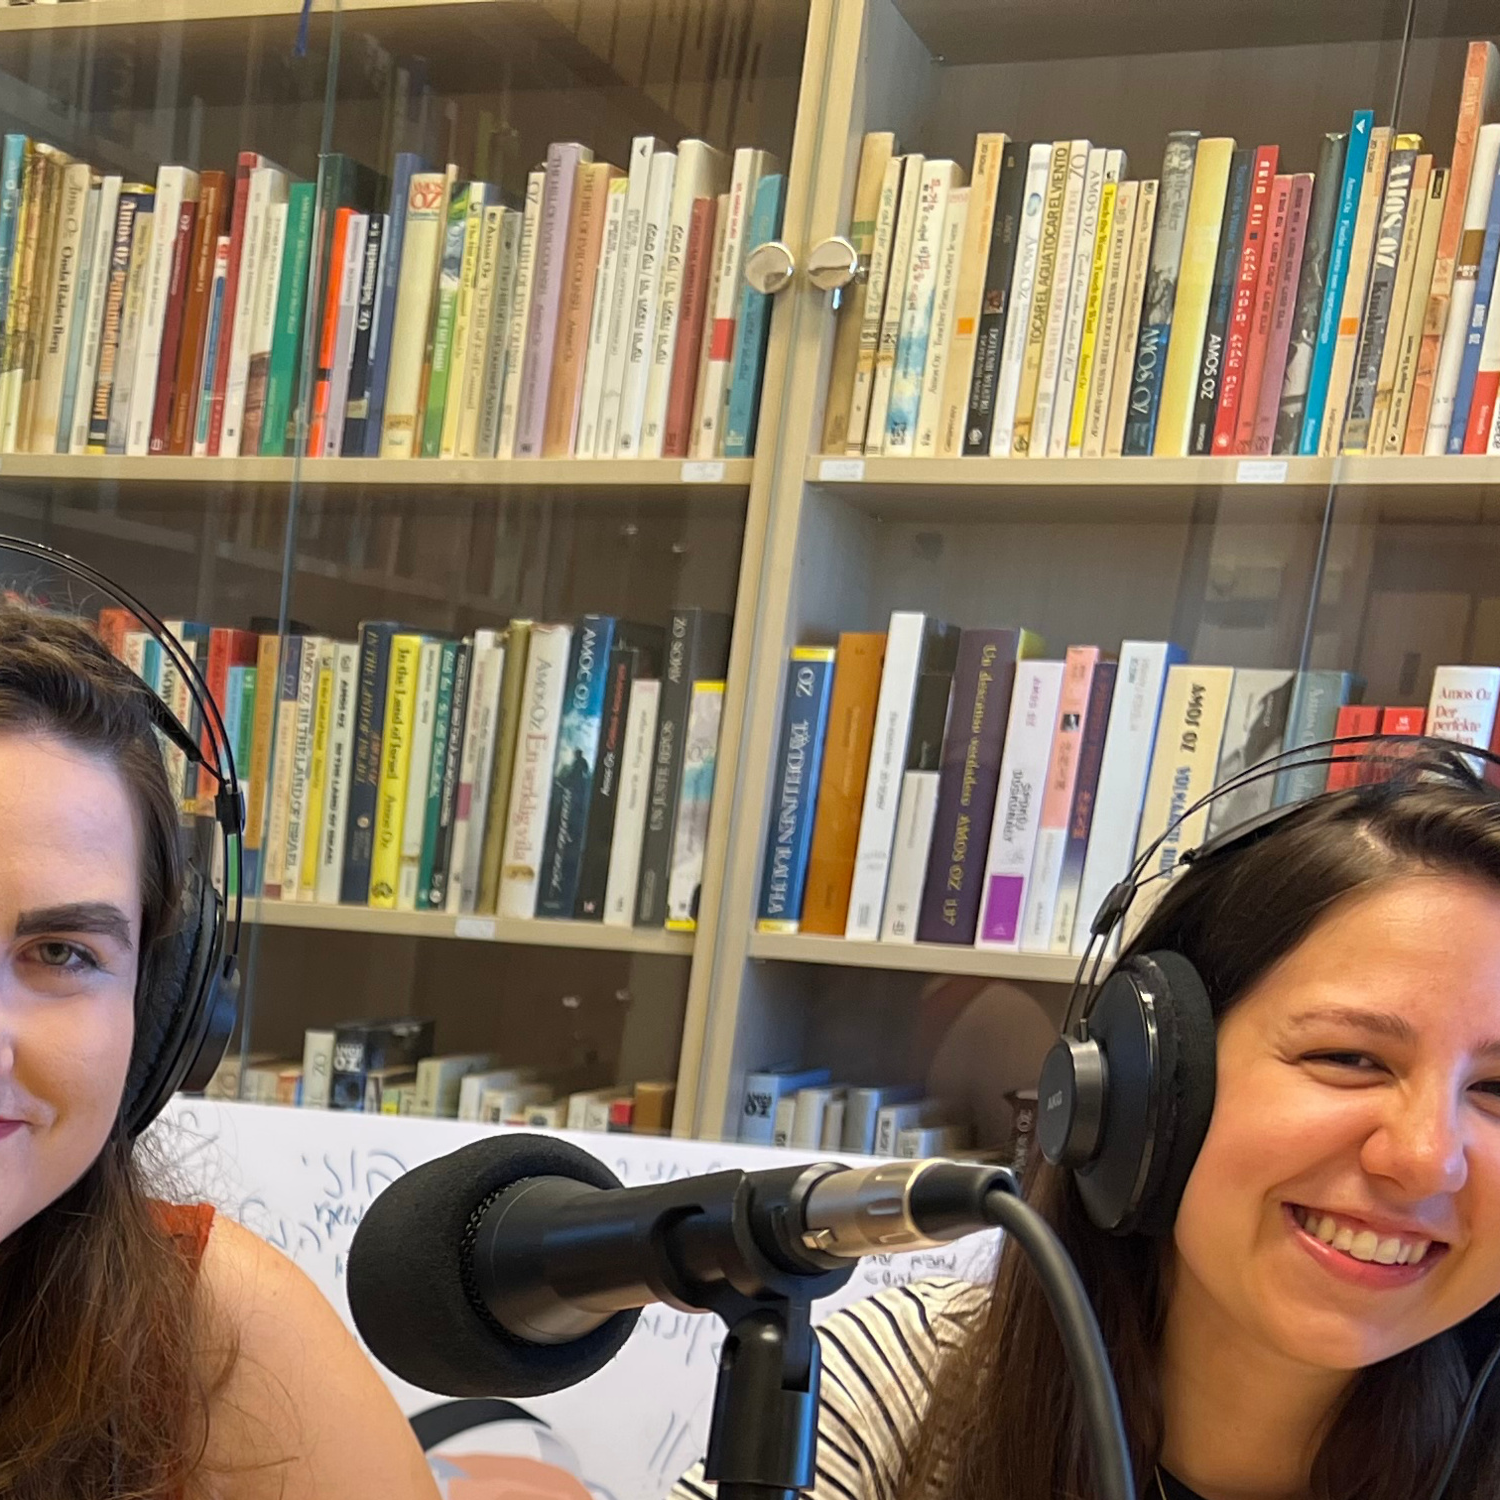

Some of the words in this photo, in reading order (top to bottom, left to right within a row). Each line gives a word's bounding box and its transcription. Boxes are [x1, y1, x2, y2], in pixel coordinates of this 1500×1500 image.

[1256, 160, 1270, 193] עמוס
[116, 200, 136, 243] Amos
[1251, 204, 1263, 225] עוז
[115, 246, 130, 265] Oz
[1134, 327, 1160, 383] AMOS
[1204, 333, 1221, 376] AMOS
[1130, 386, 1152, 416] OZ
[1200, 379, 1215, 400] OZ
[672, 617, 686, 639] OZ
[304, 641, 317, 683] AMOS
[398, 648, 409, 662] In
[669, 641, 683, 684] AMOS
[396, 665, 408, 686] the
[795, 666, 815, 699] OZ
[299, 686, 312, 704] OZ
[391, 688, 407, 726] Land
[1183, 684, 1206, 728] AMOS
[1441, 687, 1473, 700] Amos
[1477, 688, 1492, 700] Oz
[297, 708, 308, 723] IN
[1435, 705, 1458, 716] Der
[1433, 718, 1481, 733] perfekte
[294, 726, 307, 755] THE
[1180, 731, 1196, 753] OZ
[290, 757, 304, 798] LAND
[950, 813, 971, 862] AMOS
[766, 846, 792, 914] RAUHA
[948, 865, 964, 891] OZ
